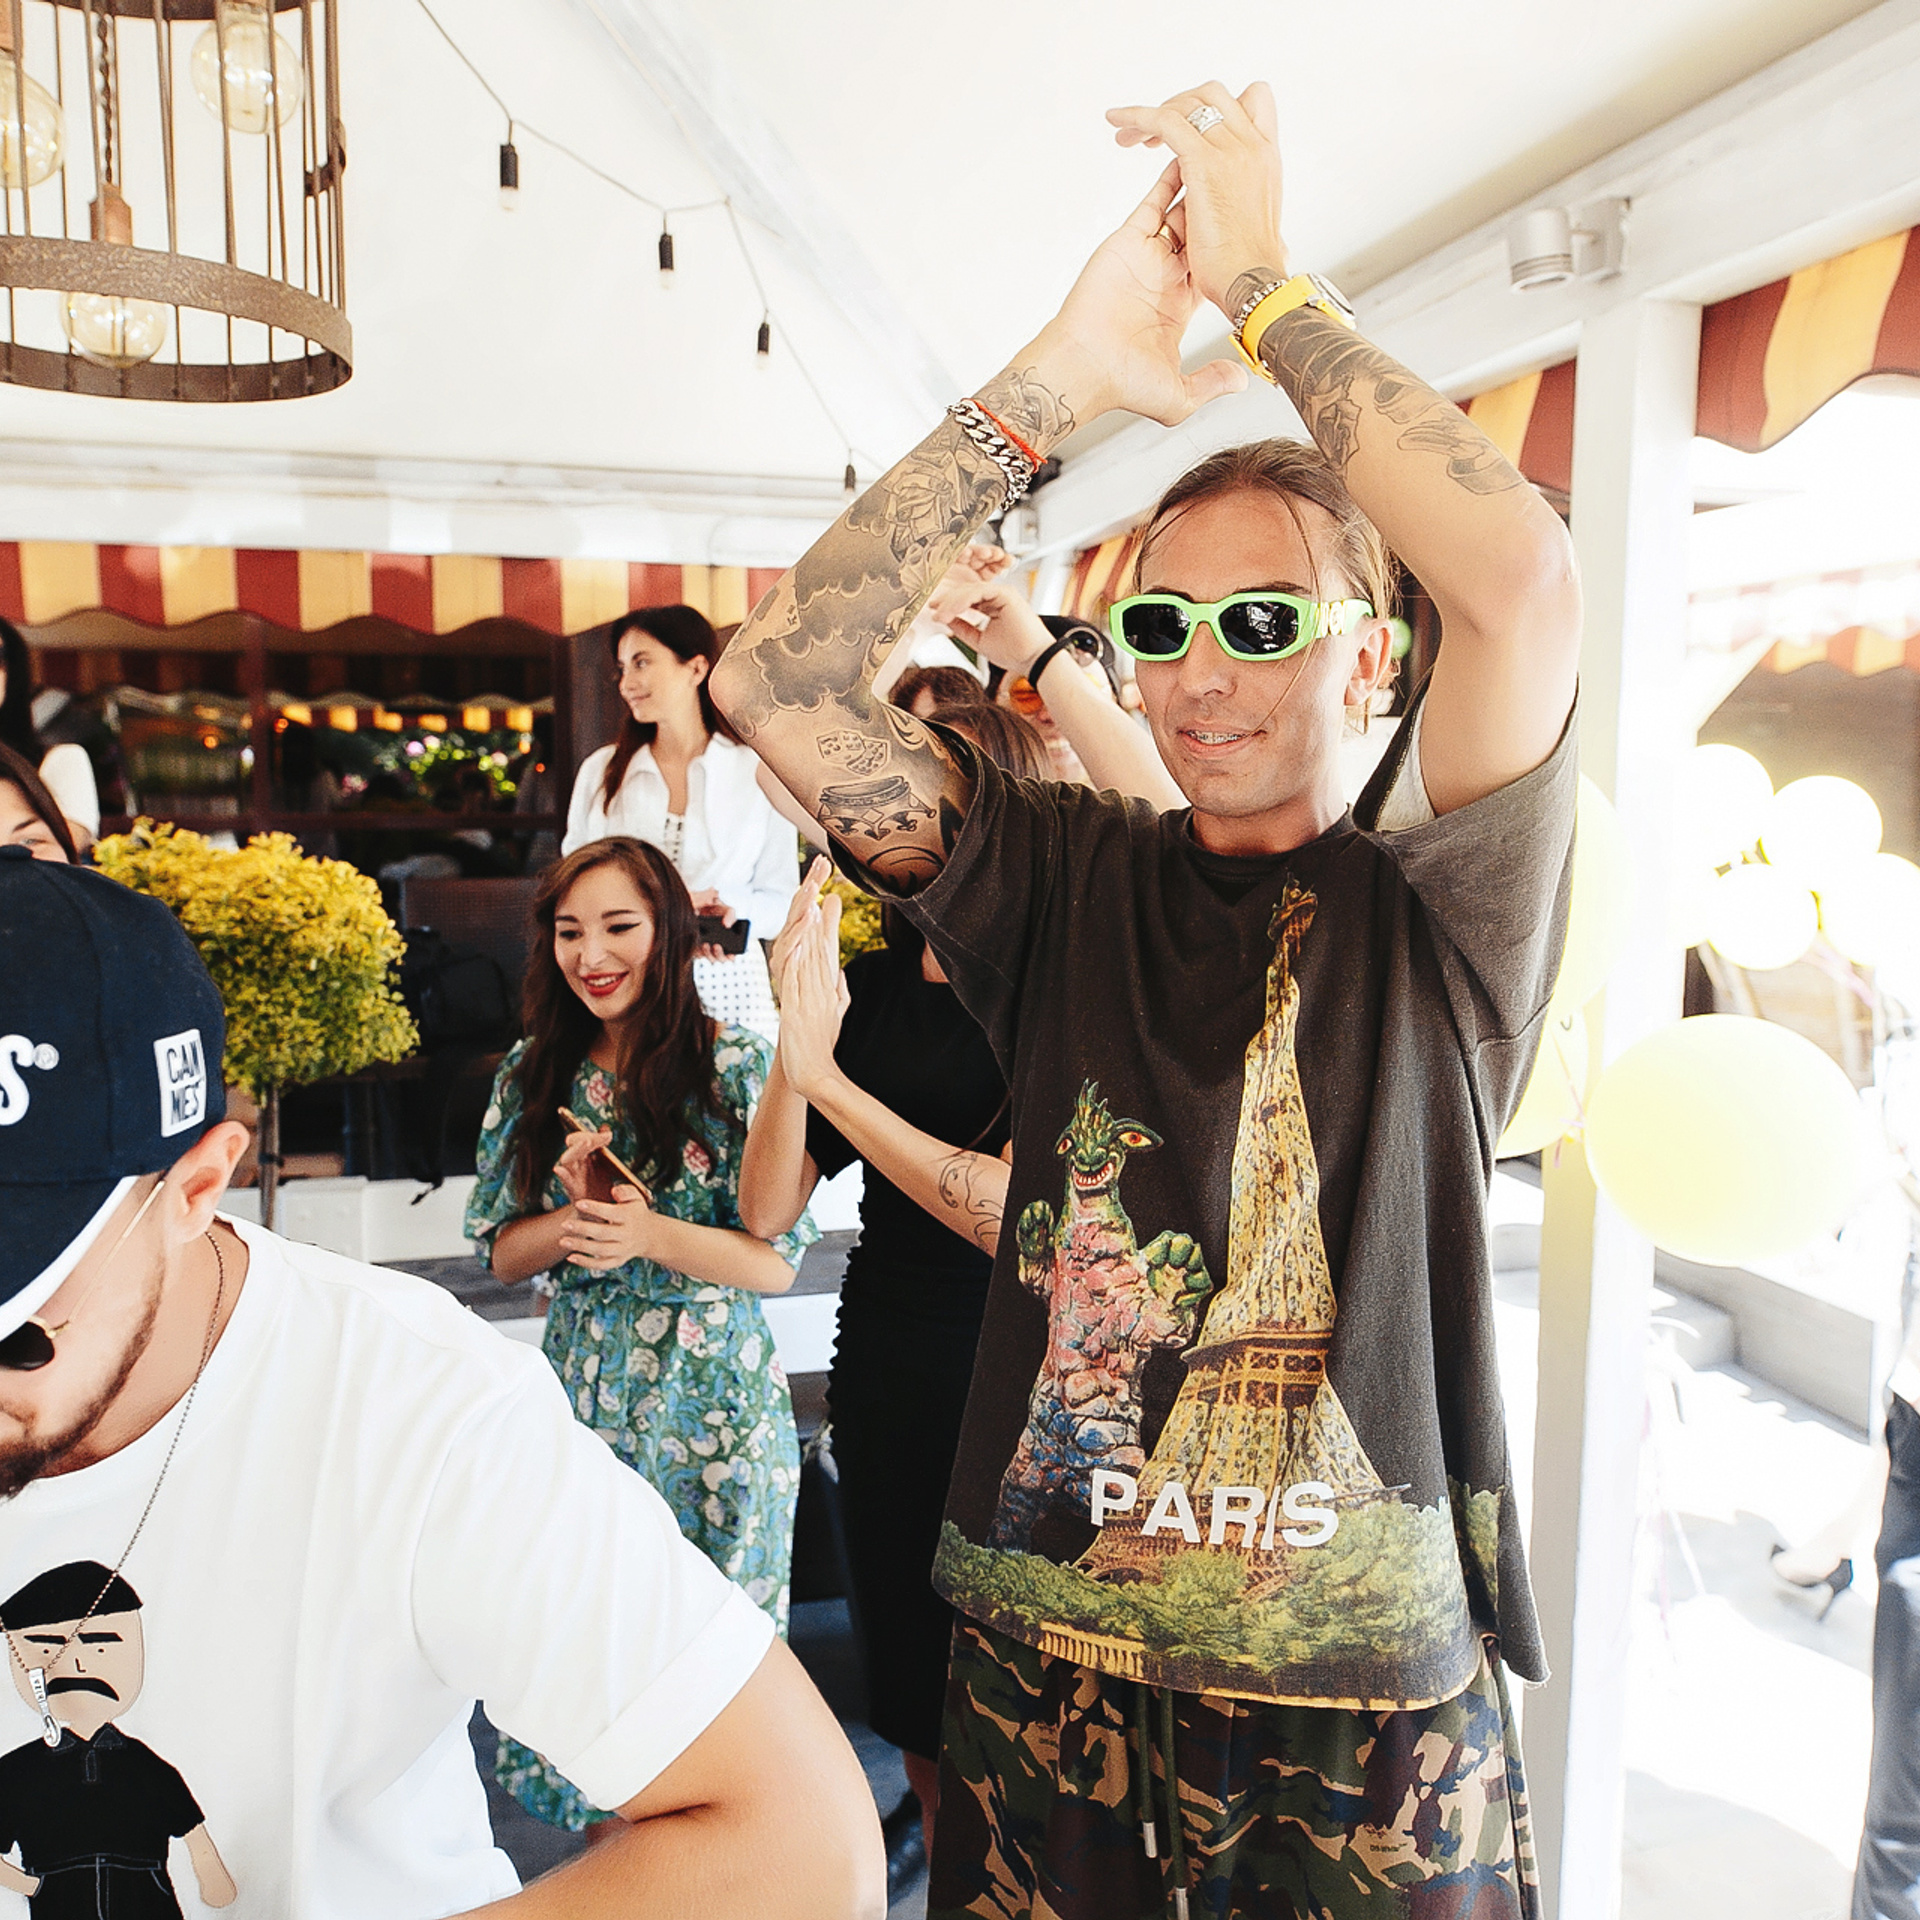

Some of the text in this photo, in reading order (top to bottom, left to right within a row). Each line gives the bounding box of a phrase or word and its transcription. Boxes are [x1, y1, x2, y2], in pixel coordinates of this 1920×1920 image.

[166, 1040, 201, 1083] CAN
[170, 1075, 203, 1125] NES
[1091, 1468, 1339, 1550] PARIS
